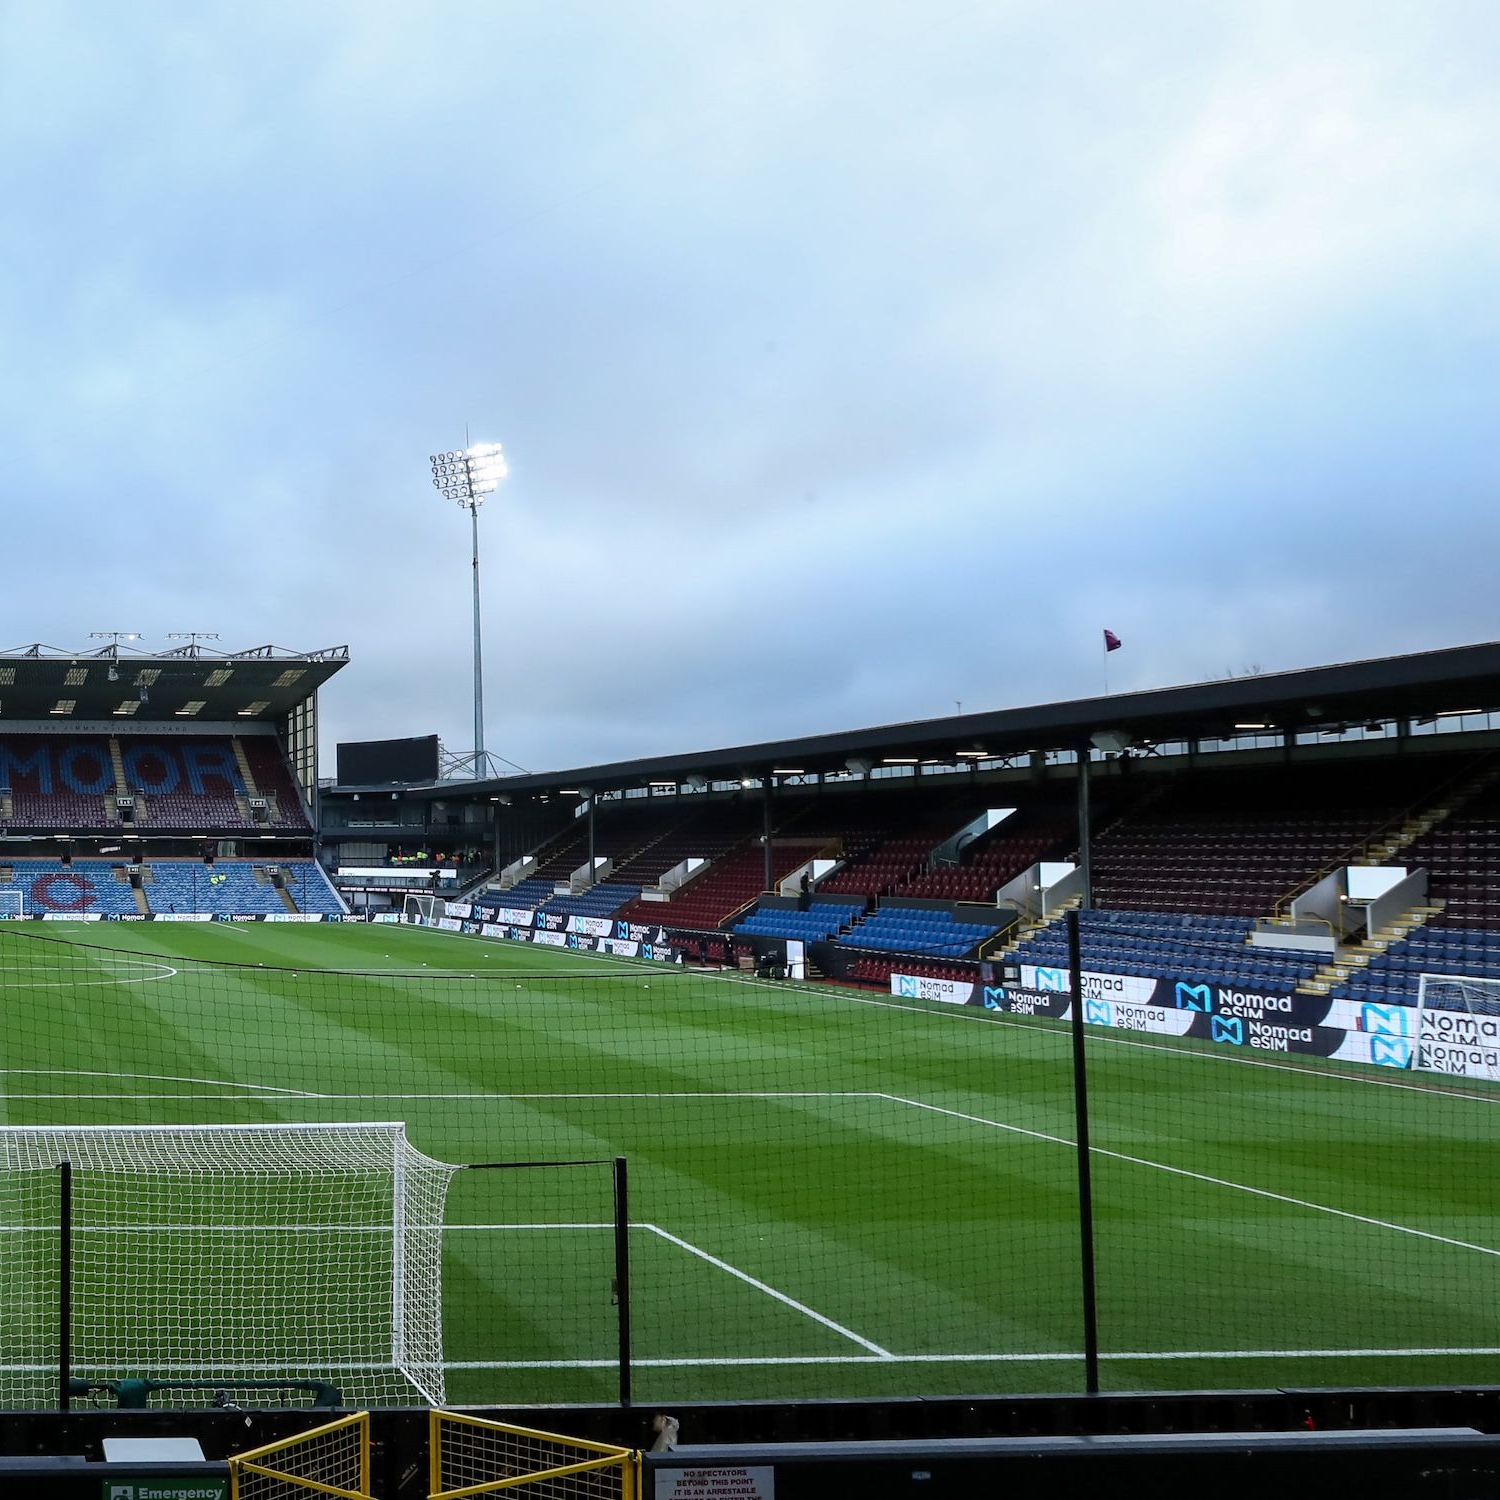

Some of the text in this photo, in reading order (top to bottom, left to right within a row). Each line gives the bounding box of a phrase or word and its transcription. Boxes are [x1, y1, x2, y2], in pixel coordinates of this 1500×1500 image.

[0, 744, 249, 795] MOOR
[546, 915, 563, 924] Nomad
[585, 920, 603, 928] Nomad
[578, 937, 593, 945] Nomad
[630, 932, 643, 941] eSIM
[614, 941, 630, 949] Nomad
[653, 946, 671, 955] Nomad
[653, 953, 665, 961] eSIM
[919, 980, 954, 993] Nomad
[1080, 976, 1123, 992] omad
[920, 990, 941, 1000] eSIM
[1008, 991, 1050, 1007] Nomad
[1080, 988, 1102, 999] SIM
[1218, 989, 1292, 1013] Nomad
[1010, 1002, 1035, 1015] eSIM
[1116, 1005, 1165, 1022] Nomad
[1220, 1006, 1264, 1019] eSIM
[1117, 1018, 1147, 1031] eSIM
[1421, 1012, 1497, 1036] Noma
[1248, 1021, 1313, 1042] Nomad
[1250, 1036, 1288, 1052] eSIM
[1420, 1043, 1498, 1067] Nomad
[697, 1469, 747, 1477] SPECTATORS
[138, 1487, 223, 1500] Emergency
[706, 1487, 756, 1495] ARRESTABLE
